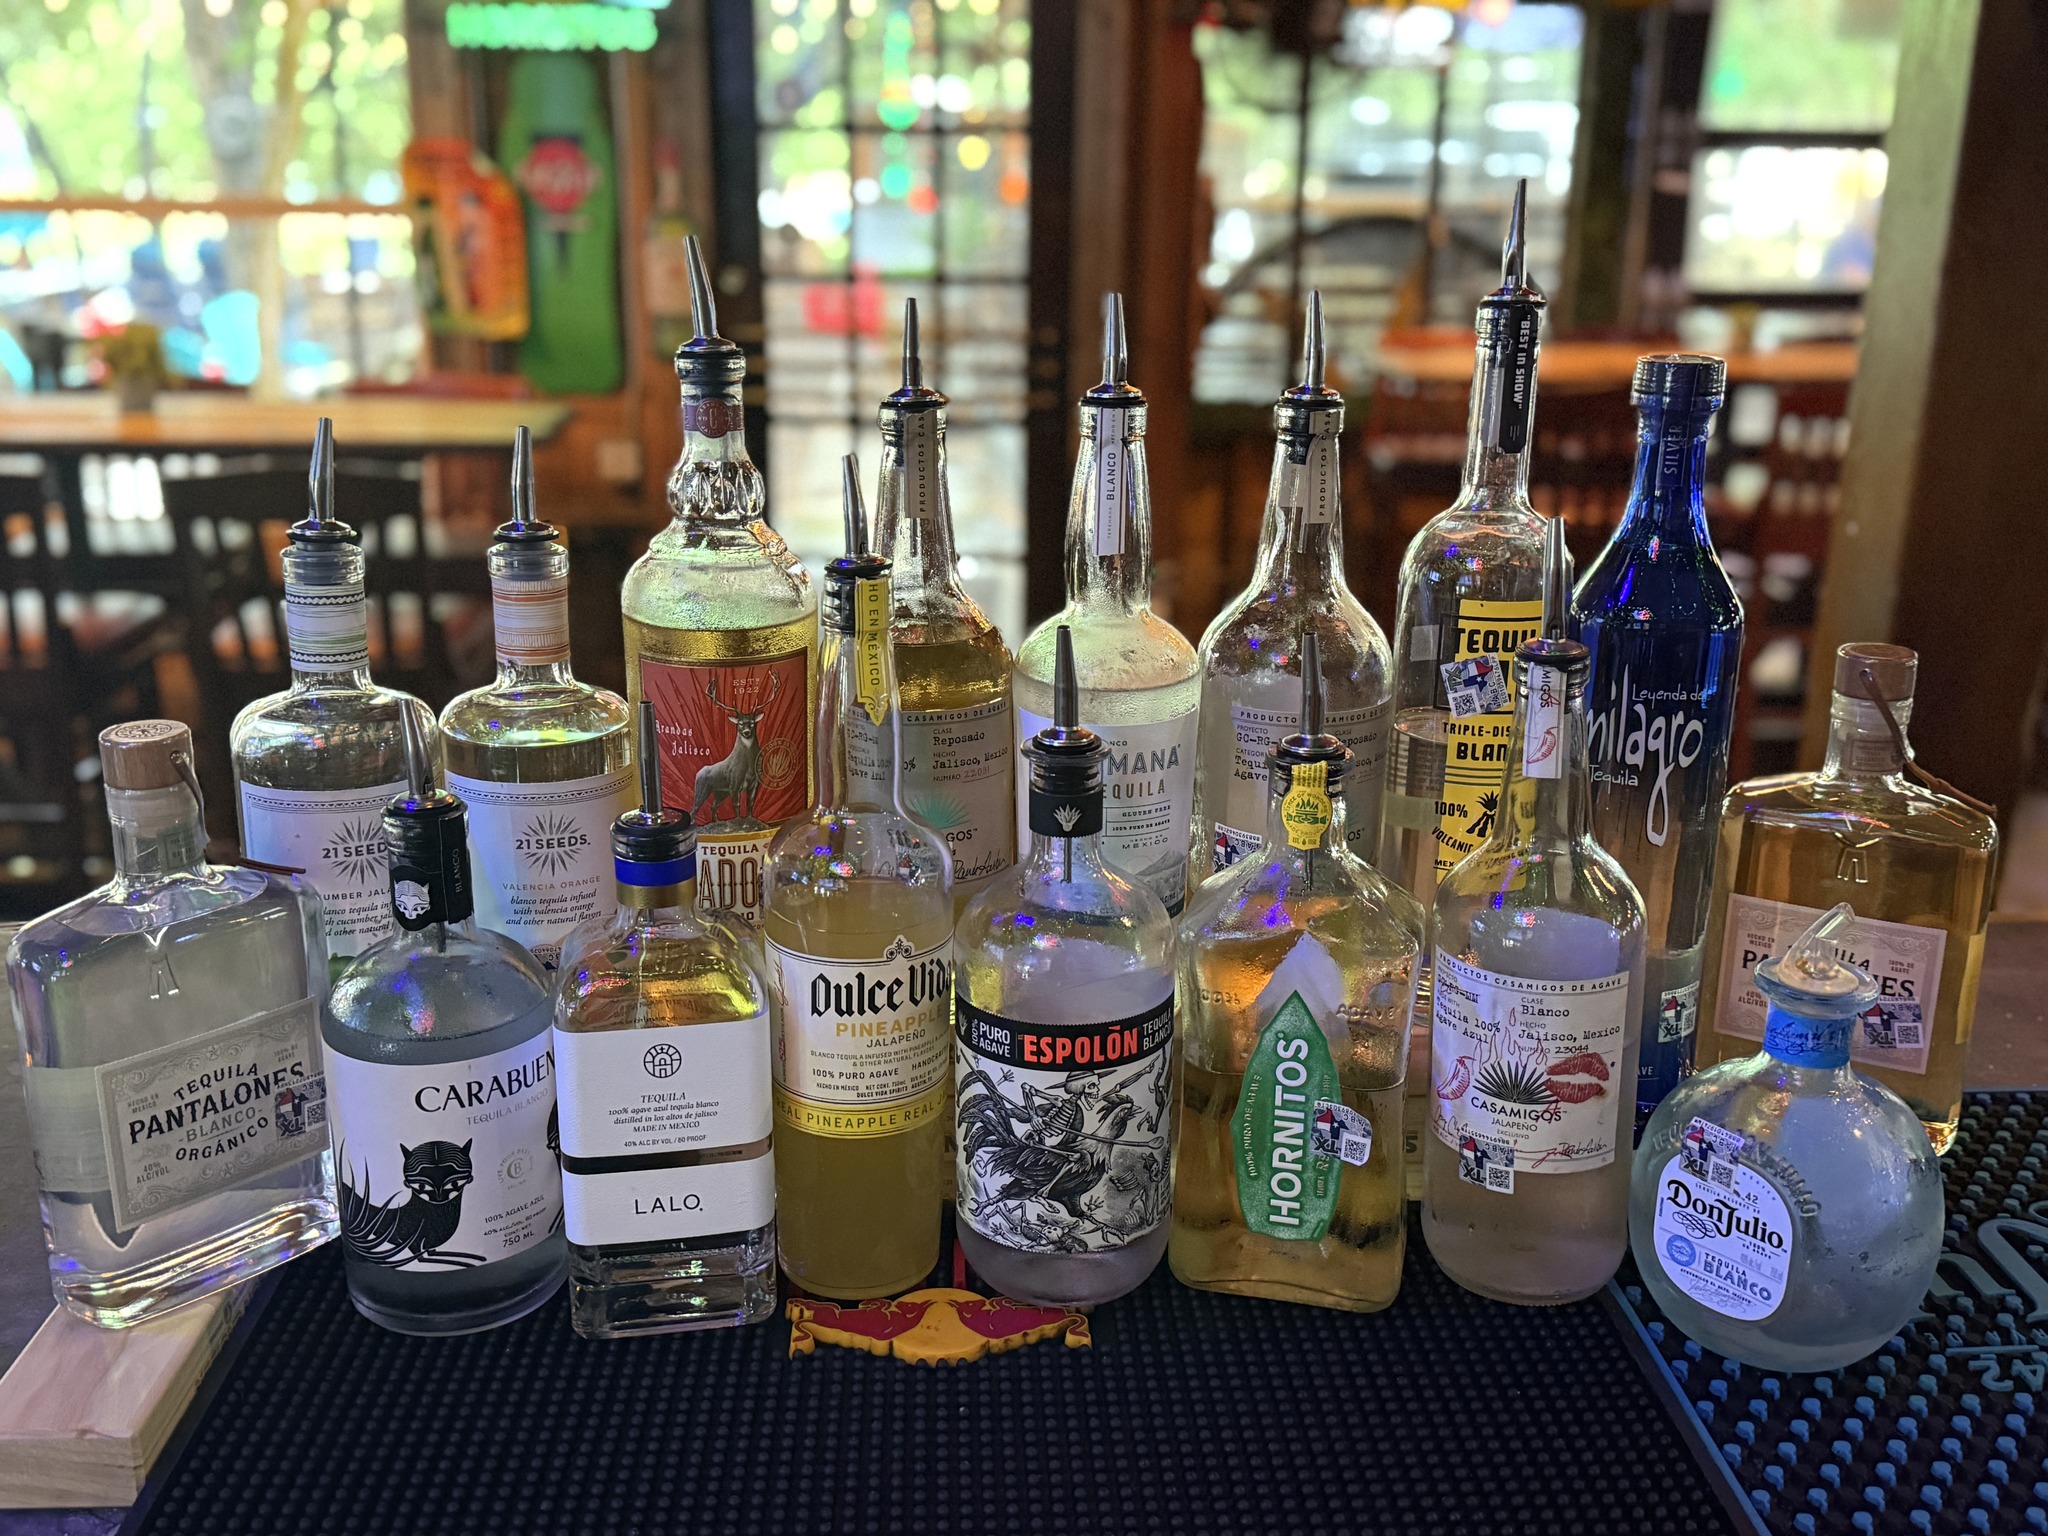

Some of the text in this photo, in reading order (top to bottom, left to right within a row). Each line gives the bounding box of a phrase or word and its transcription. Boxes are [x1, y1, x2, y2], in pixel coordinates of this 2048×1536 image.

[1512, 368, 1525, 409] SHOW"
[1664, 425, 1682, 475] SILVER
[918, 444, 926, 513] PRODUCTOS
[1106, 452, 1117, 501] BLANCO
[1319, 447, 1328, 517] PRODUCTOS
[868, 610, 881, 687] EN MÉXICO
[733, 687, 760, 695] 1922
[1632, 683, 1687, 710] Leyenda
[907, 710, 983, 722] CASAMIGOS DE
[1240, 711, 1297, 724] PRODUCTO
[655, 719, 693, 736] Arandas
[1237, 724, 1268, 735] PROYECTO
[1443, 721, 1510, 738] TRIPLE-DIS
[932, 731, 985, 747] Reposado
[671, 739, 711, 757] Jalisco
[932, 755, 981, 770] Jalisco,
[1107, 744, 1181, 776] MANÁ
[1234, 768, 1267, 782] Agave
[1589, 764, 1639, 795] Tequila
[1102, 778, 1165, 800] EQUILA
[1122, 805, 1171, 818] GLUTEN FREE
[1434, 801, 1469, 818] 100%
[1112, 818, 1171, 832] 100% PURO DE AGAVE
[322, 842, 388, 859] 21 SEED
[515, 838, 531, 850] 21
[701, 844, 759, 857] TEQUILA
[454, 849, 463, 894] BLANCO
[502, 875, 600, 891] VALENCIA ORANGE
[698, 857, 758, 911] ADO
[510, 888, 597, 906] blanco tequila infused
[348, 903, 379, 916] tequila
[513, 902, 595, 915] with valencia orange
[336, 912, 378, 926] cucumber
[506, 913, 577, 926] and other natural
[334, 922, 390, 936] other natural
[1440, 953, 1488, 981] PRODUCTOS
[1494, 977, 1564, 992] CASAMIGOS
[1571, 984, 1585, 992] DE
[1591, 978, 1621, 990] AGAVE
[811, 971, 904, 1018] Dulce
[1521, 996, 1544, 1005] CLASE
[1521, 1005, 1570, 1017] Blanco
[836, 1004, 944, 1037] PINEAPPLE
[980, 1021, 1011, 1045] PURO
[1143, 1011, 1172, 1036] TEQUILA
[1474, 1018, 1500, 1033] 100%
[1520, 1021, 1547, 1029] HECHO
[866, 1028, 927, 1048] JALAPEÑO
[971, 1018, 979, 1045] 100%
[1462, 1028, 1489, 1044] Azul
[1519, 1025, 1621, 1043] Jalisco, Mexico
[978, 1023, 1172, 1058] AGAVE BLANCO
[811, 1050, 835, 1060] BLANCO
[836, 1053, 864, 1061] TEQUILA
[865, 1051, 892, 1060] INFUSED
[893, 1048, 908, 1057] WITH
[860, 1059, 882, 1067] OTHER
[883, 1054, 912, 1065] NATURAL
[415, 1050, 556, 1113] CARABUEN
[812, 1068, 835, 1079] 100%
[838, 1071, 865, 1080] PURO
[869, 1067, 899, 1079] AGAVE
[173, 1063, 259, 1102] TEQUILA
[816, 1082, 832, 1090] HECHO
[865, 1083, 875, 1091] NET
[889, 1085, 908, 1096] SPIRITS
[128, 1061, 304, 1145] PANTALONES
[640, 1092, 687, 1104] TEQUILA
[466, 1088, 549, 1126] TEQUILA BLANCO
[608, 1100, 719, 1116] 100% agave azul tequila blanco
[807, 1101, 935, 1130] PINEAPPLE REAL
[1471, 1096, 1562, 1122] CASAMIGOS
[613, 1115, 643, 1125] distilled
[644, 1114, 653, 1122] in
[665, 1112, 683, 1121] altos
[684, 1111, 693, 1119] de
[693, 1110, 718, 1120] jalisco
[1243, 1074, 1263, 1178] 100% PURO DE AGAVE
[1491, 1117, 1538, 1132] JALAPEÑO
[633, 1120, 700, 1133] MADE IN MEXICO
[1269, 1037, 1309, 1226] HORNITOS
[1497, 1129, 1530, 1140] EXCLUSIVO
[175, 1116, 269, 1161] ORGÁNICO
[686, 1134, 706, 1142] PROOF
[136, 1166, 170, 1184] ALC/VOL
[143, 1161, 162, 1173] 40%
[484, 1204, 528, 1224] 100% AGAVE
[483, 1228, 498, 1237] 40%
[502, 1230, 535, 1248] 750 ML
[1704, 1252, 1747, 1277] TEQUILA
[1703, 1260, 1772, 1302] BLANCO
